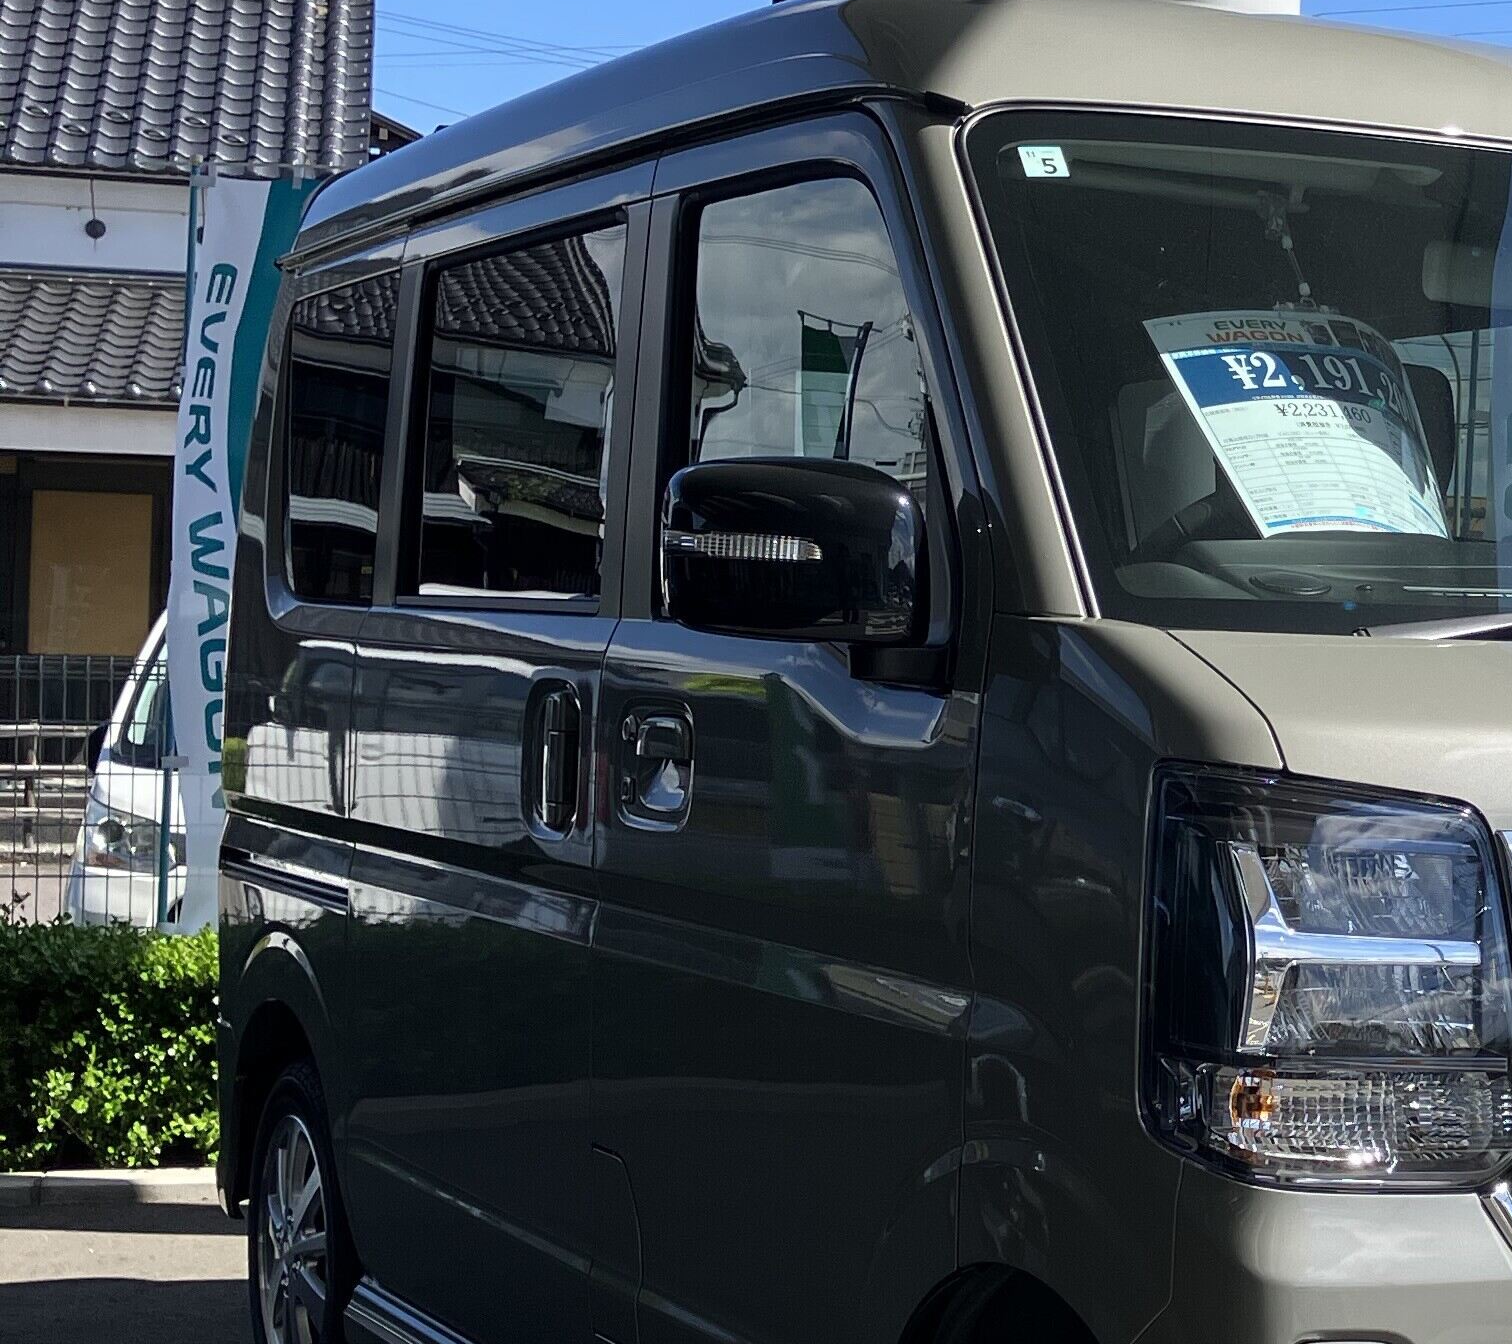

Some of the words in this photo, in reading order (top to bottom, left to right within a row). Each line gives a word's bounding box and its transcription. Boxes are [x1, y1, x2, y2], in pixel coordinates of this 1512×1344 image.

[1041, 158, 1058, 175] 5
[1214, 320, 1286, 331] EVERY
[1207, 330, 1304, 343] WAGON
[184, 262, 238, 494] EVERY
